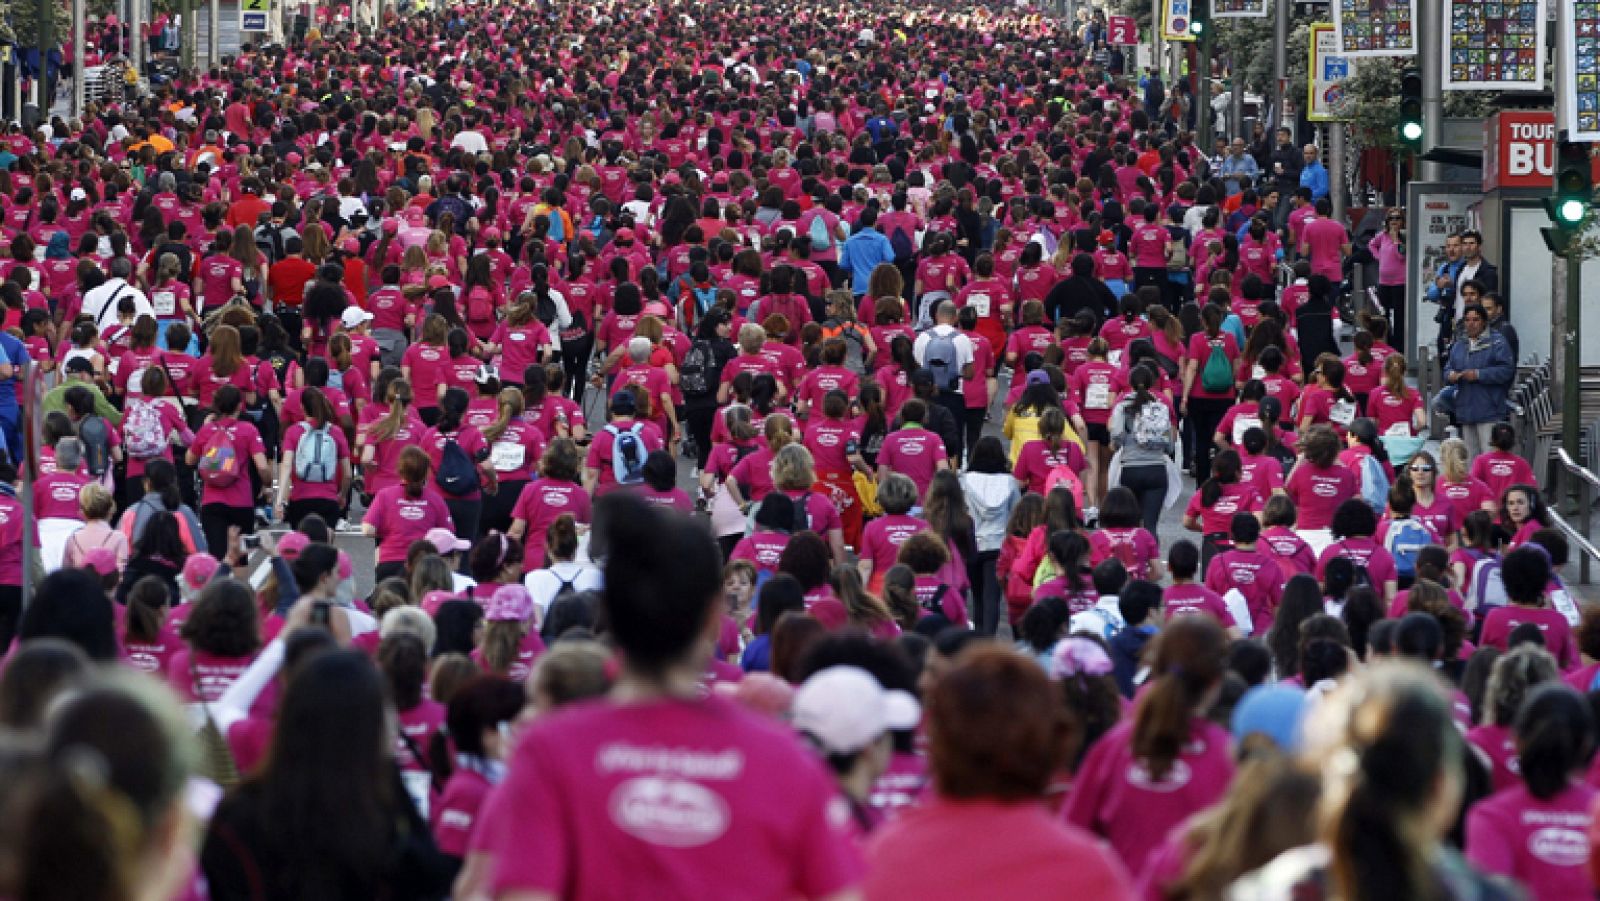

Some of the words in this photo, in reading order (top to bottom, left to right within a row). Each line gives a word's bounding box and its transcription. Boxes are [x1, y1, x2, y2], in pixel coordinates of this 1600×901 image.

[1114, 26, 1125, 43] 2
[1510, 123, 1555, 139] TOUR
[1509, 143, 1555, 175] BU
